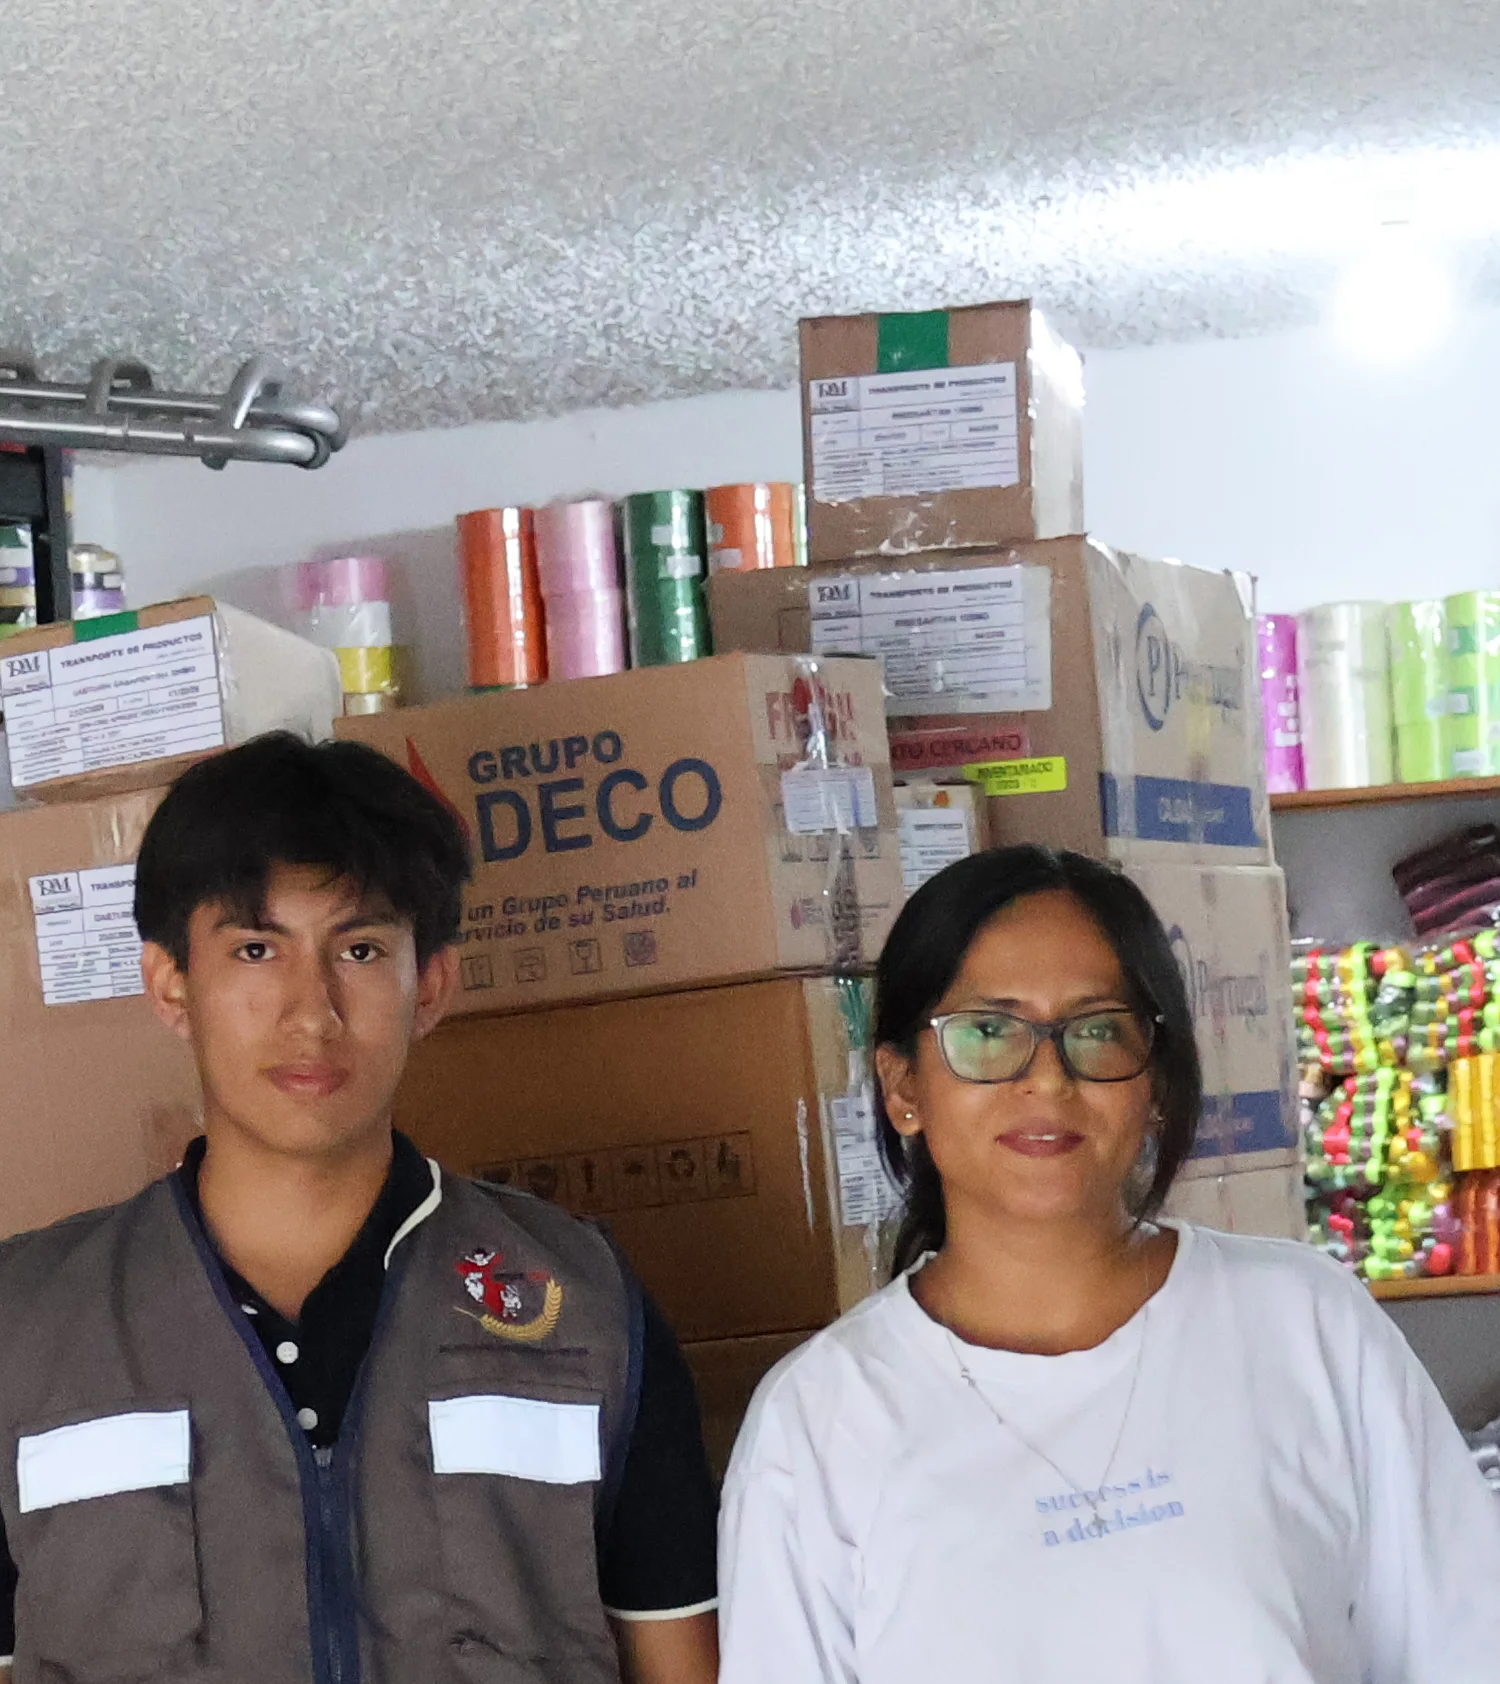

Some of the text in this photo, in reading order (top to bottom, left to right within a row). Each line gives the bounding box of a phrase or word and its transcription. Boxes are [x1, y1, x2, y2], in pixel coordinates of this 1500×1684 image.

[60, 632, 203, 669] TRANSPORTE DE PRODUCTOS
[467, 730, 624, 785] GRUPO
[474, 757, 723, 863] DECO
[90, 879, 136, 891] TRANSPO
[467, 869, 698, 922] un Grupo Peruano al
[454, 897, 671, 943] ervicio de su Salud.
